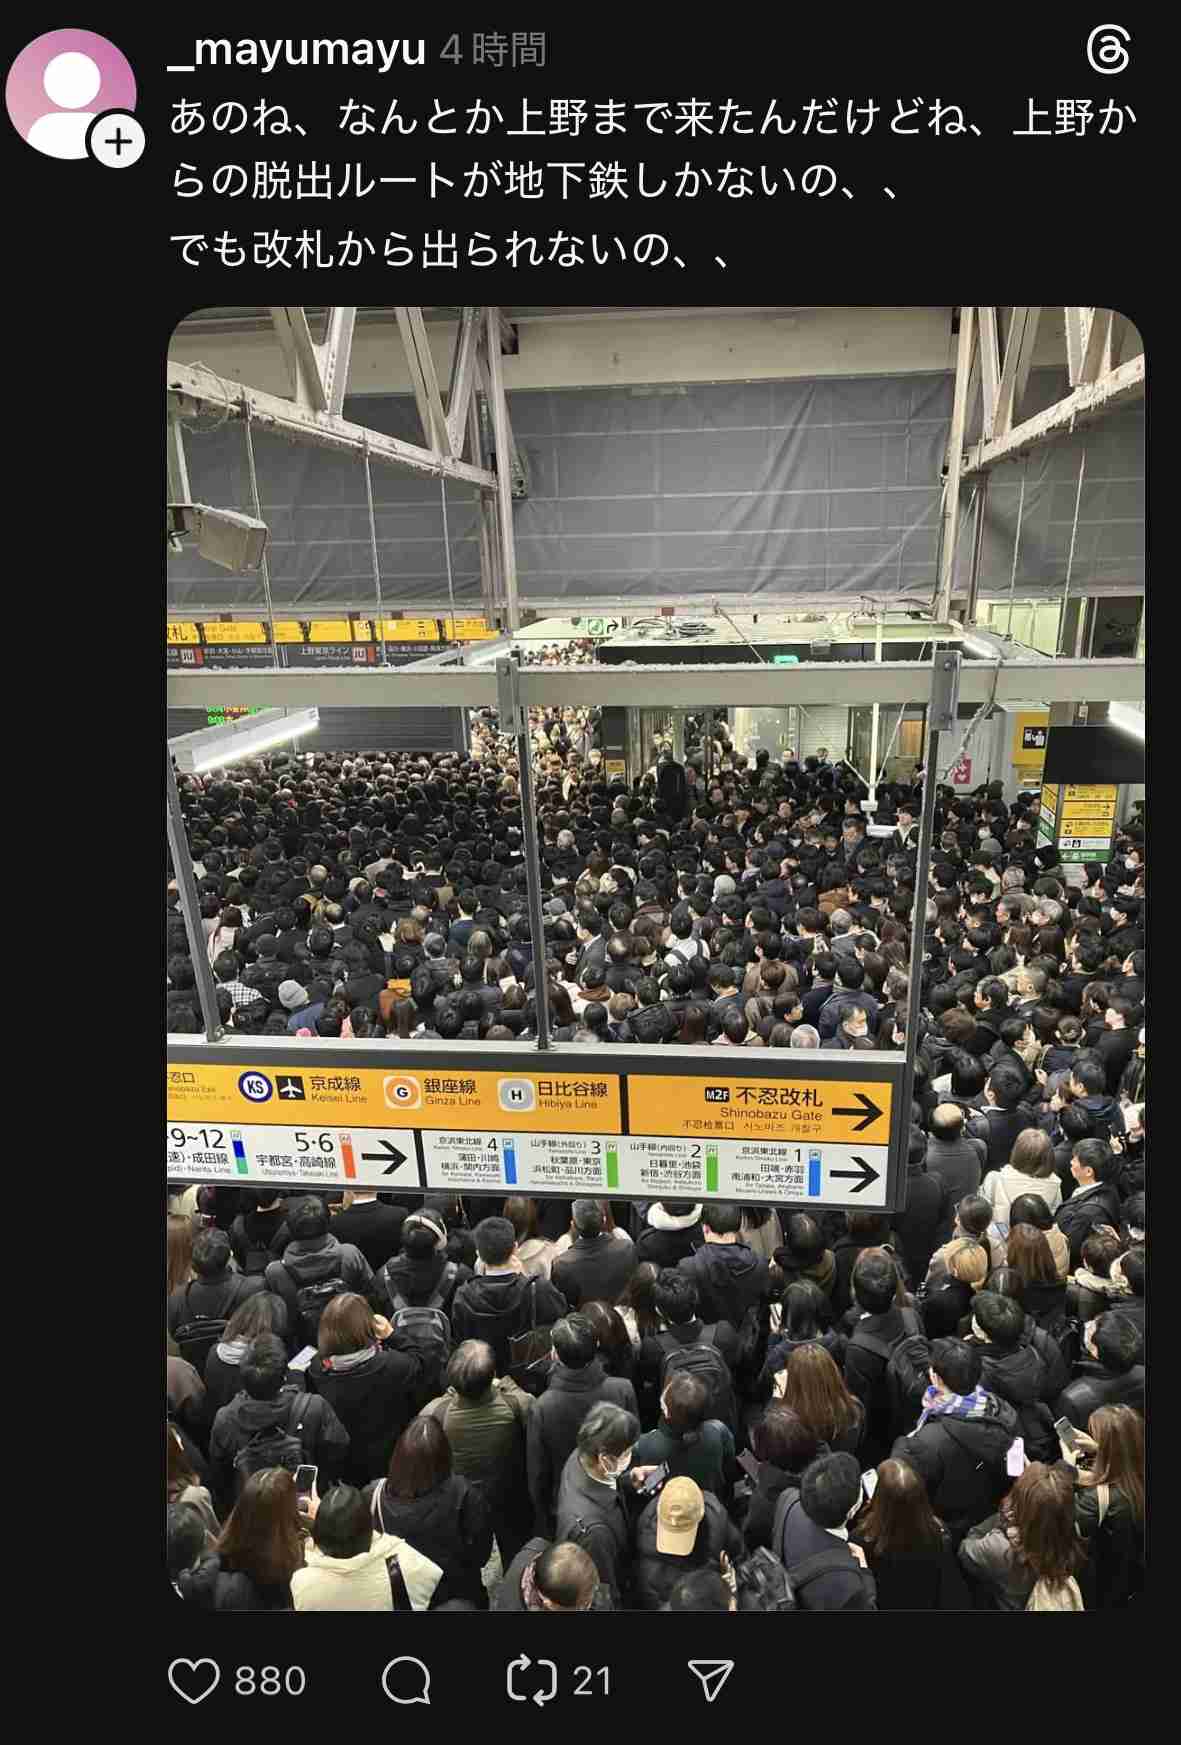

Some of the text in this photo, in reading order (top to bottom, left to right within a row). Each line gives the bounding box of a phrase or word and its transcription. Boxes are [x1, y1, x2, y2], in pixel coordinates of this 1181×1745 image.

[246, 1079, 265, 1095] KS
[310, 1075, 361, 1092] 京成線
[424, 1078, 478, 1095] 銀座線
[538, 1081, 609, 1098] 日比谷線
[396, 1087, 409, 1098] G
[511, 1089, 523, 1101] H
[706, 1089, 730, 1103] M2F
[735, 1087, 825, 1107] 不忍改札
[425, 1096, 481, 1107] Ginza Line
[539, 1098, 599, 1110] Hibiya Line
[720, 1106, 823, 1121] Shinobazu Gate
[487, 1138, 498, 1152] 4
[591, 1140, 601, 1154] 3
[691, 1144, 702, 1158] 2
[793, 1149, 801, 1163] 1
